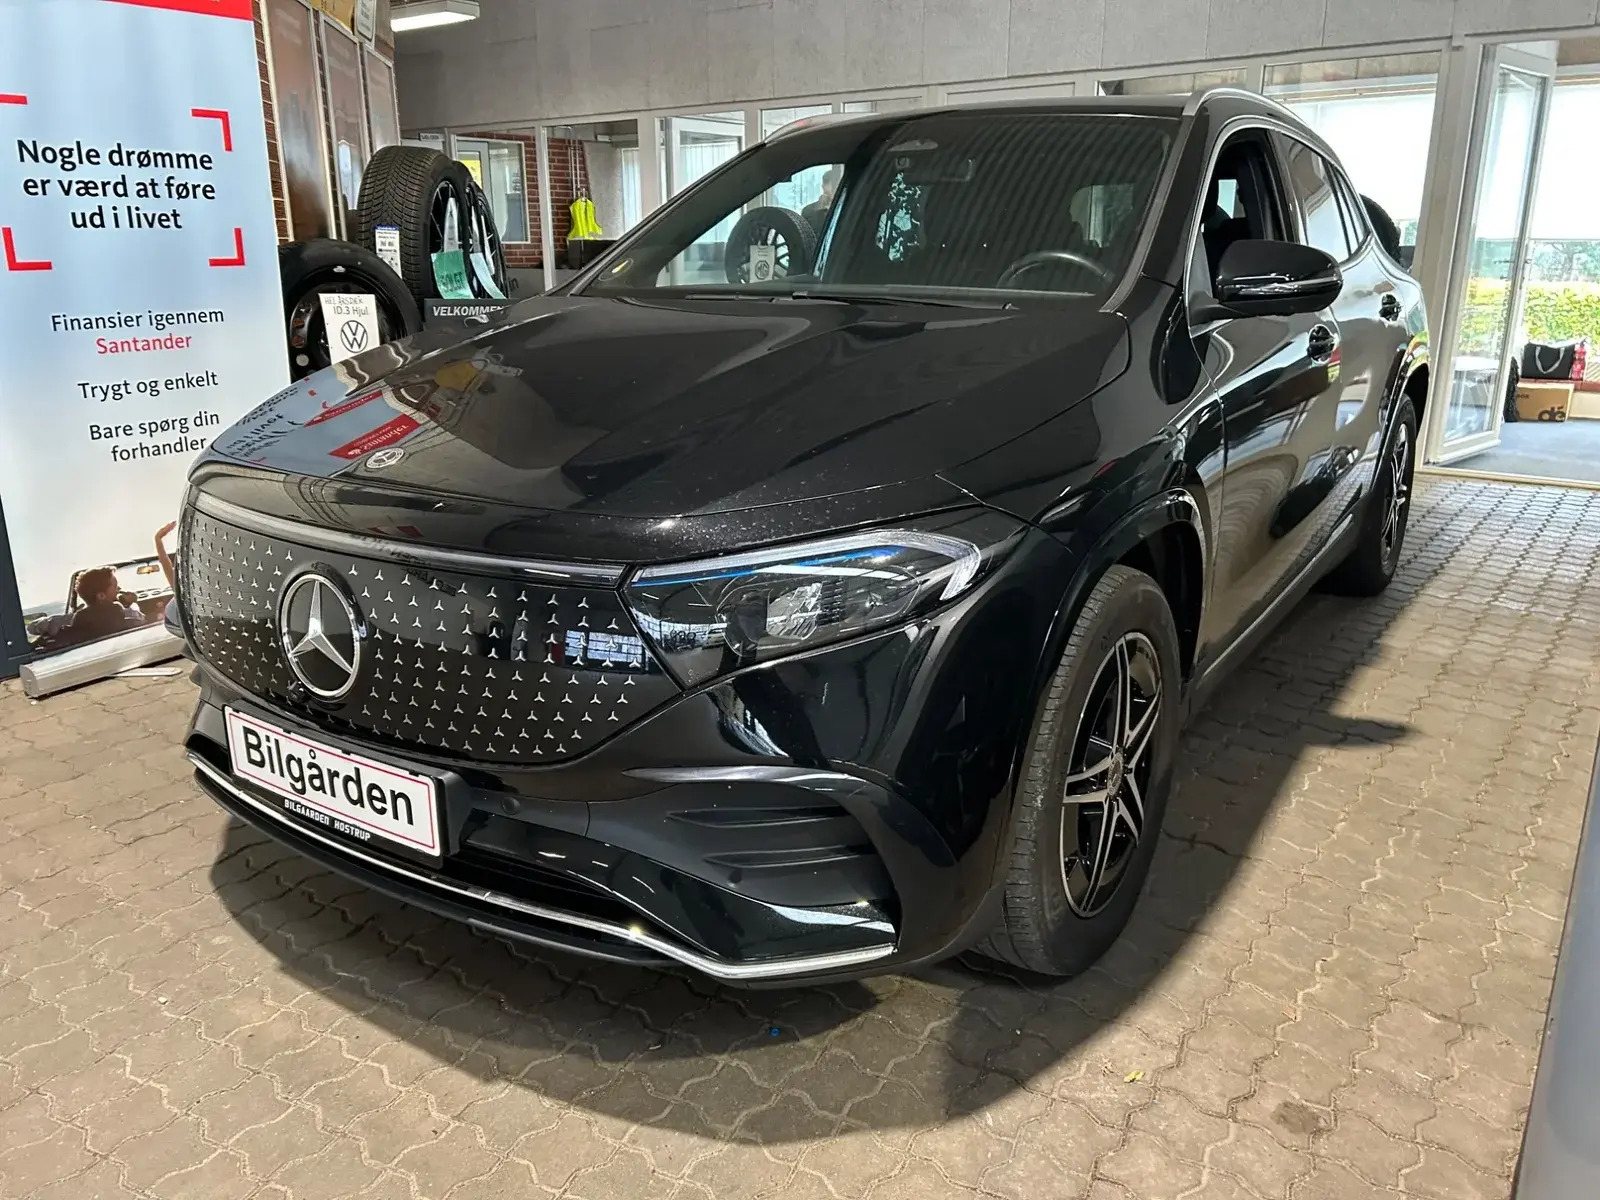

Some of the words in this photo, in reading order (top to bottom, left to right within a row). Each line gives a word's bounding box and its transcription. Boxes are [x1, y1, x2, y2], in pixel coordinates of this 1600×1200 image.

[17, 140, 101, 172] Nogle
[108, 143, 213, 170] drømme
[23, 178, 51, 197] er
[57, 175, 129, 198] værd
[136, 178, 161, 199] at
[164, 175, 216, 203] føre
[70, 204, 106, 229] ud
[111, 206, 118, 229] i
[127, 206, 183, 230] livet
[51, 312, 143, 332] Finansier
[148, 309, 225, 331] igennem
[96, 332, 192, 355] Santander
[77, 380, 132, 403] Trygt
[136, 381, 161, 397] og
[164, 370, 219, 391] enkelt
[89, 423, 133, 441] Bare
[138, 418, 190, 438] spørg
[193, 410, 220, 428] din
[110, 435, 207, 462] forhandler
[241, 724, 415, 826] Bilgården
[284, 799, 330, 826] BILGAARDEN
[334, 820, 371, 842] HOSTRUP
